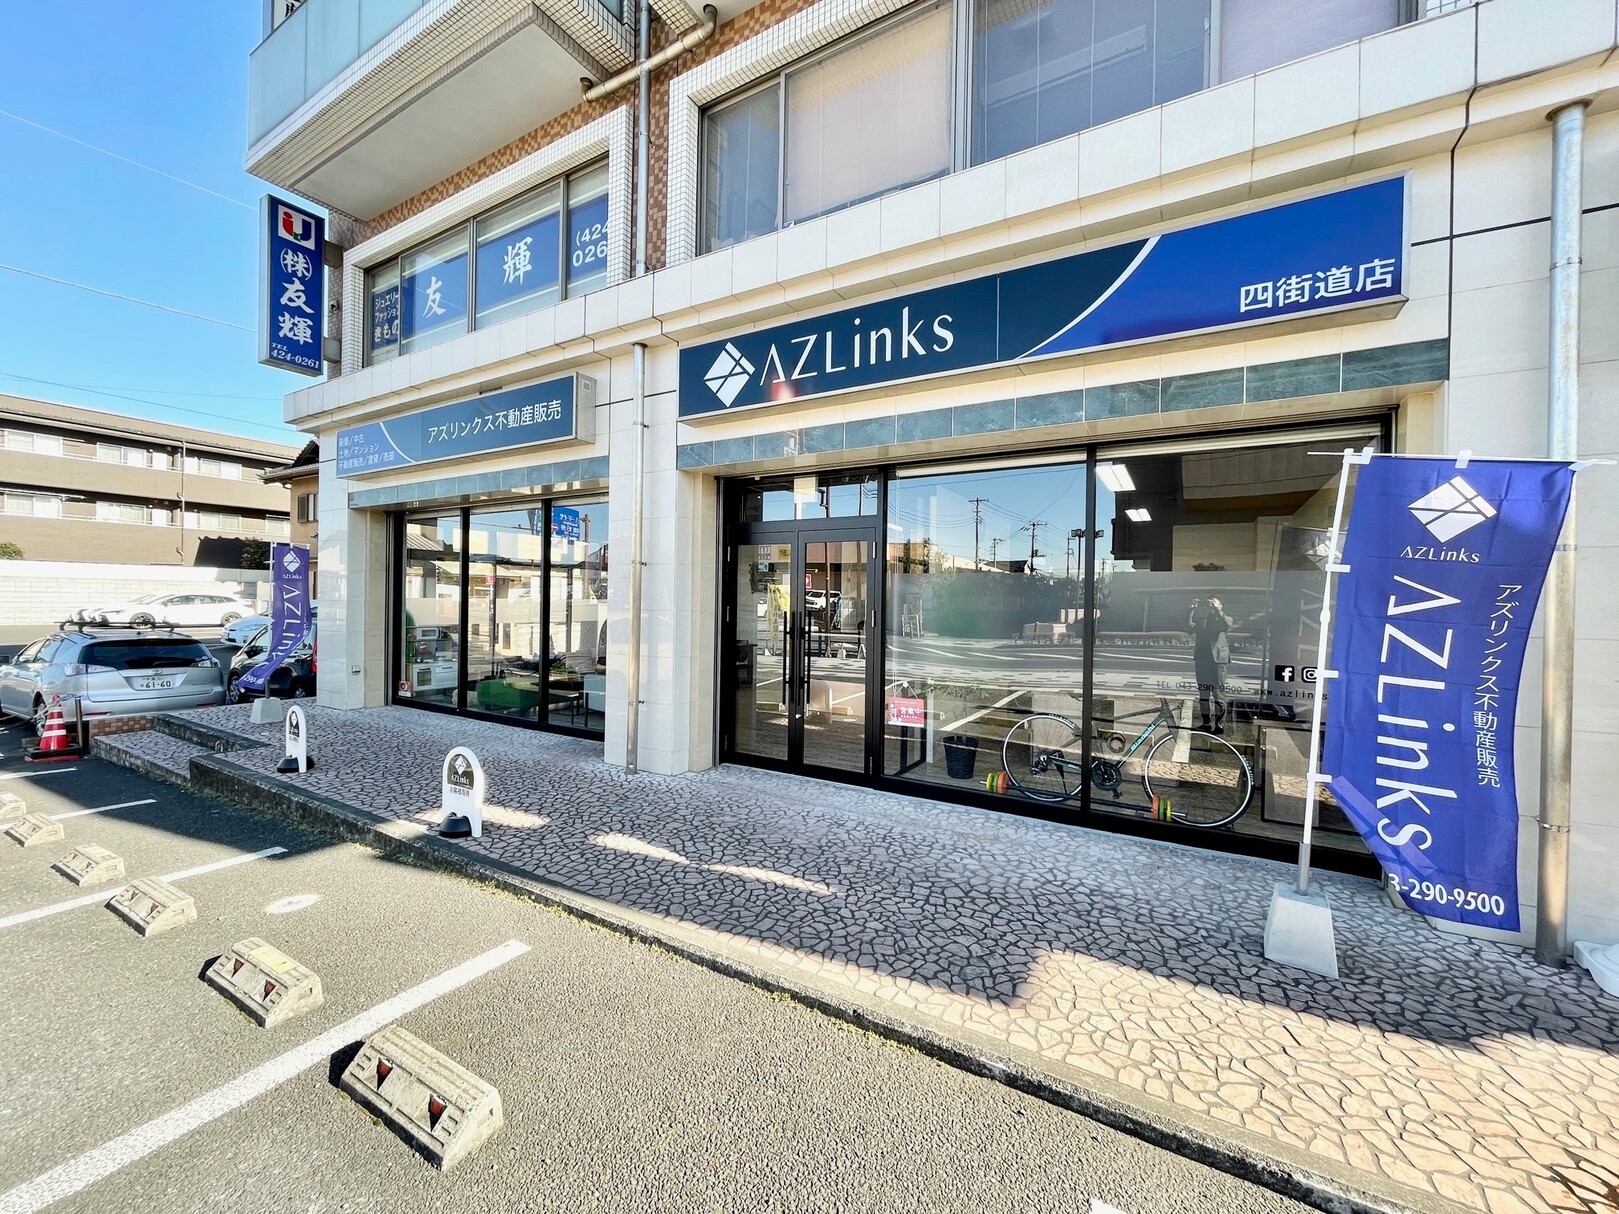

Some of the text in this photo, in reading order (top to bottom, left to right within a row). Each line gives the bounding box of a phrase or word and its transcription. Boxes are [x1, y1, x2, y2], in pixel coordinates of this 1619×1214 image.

[422, 236, 533, 319] 友 輝
[1239, 258, 1396, 313] 四街道店
[271, 343, 288, 352] TEL
[374, 320, 400, 342] きもの
[759, 306, 955, 387] AZLinks
[271, 350, 320, 370] 424-0261
[428, 399, 562, 444] アズリンクス不動産販売
[1400, 545, 1481, 563] AZLinks
[145, 680, 172, 689] 61-60
[1156, 680, 1172, 689] TEL
[1175, 682, 1243, 695] 043-290-9500
[1473, 584, 1523, 788] アズリンクス不動産販売
[1376, 575, 1461, 850] AZLinks
